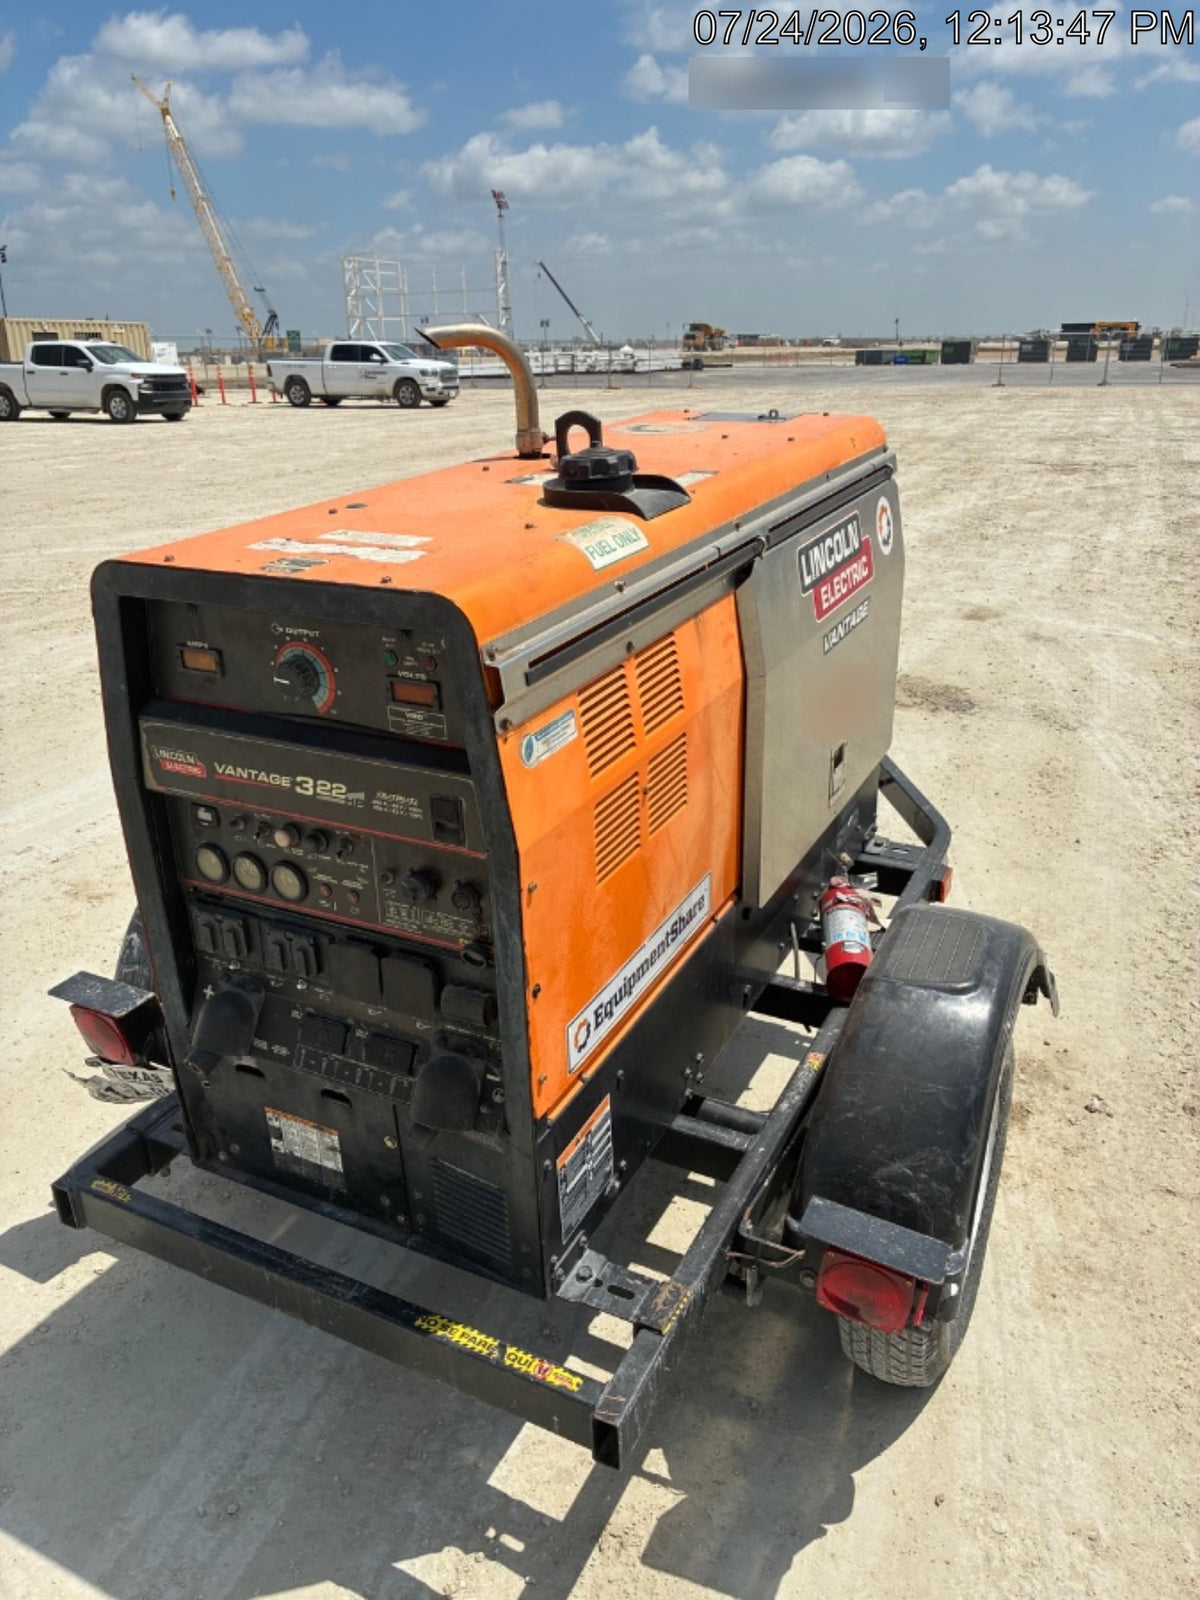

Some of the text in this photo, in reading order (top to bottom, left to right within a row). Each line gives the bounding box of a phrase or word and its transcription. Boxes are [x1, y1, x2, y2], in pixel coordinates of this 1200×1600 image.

[584, 539, 617, 561] FUEL
[612, 527, 641, 549] ONLY
[801, 519, 860, 586] LINCOLN
[820, 554, 869, 611] ELECTRIC
[823, 600, 869, 653] VANTAGE
[214, 762, 346, 799] VANTAGE 322
[593, 894, 705, 1030] EquipmentShare
[115, 1070, 164, 1084] TEXAS
